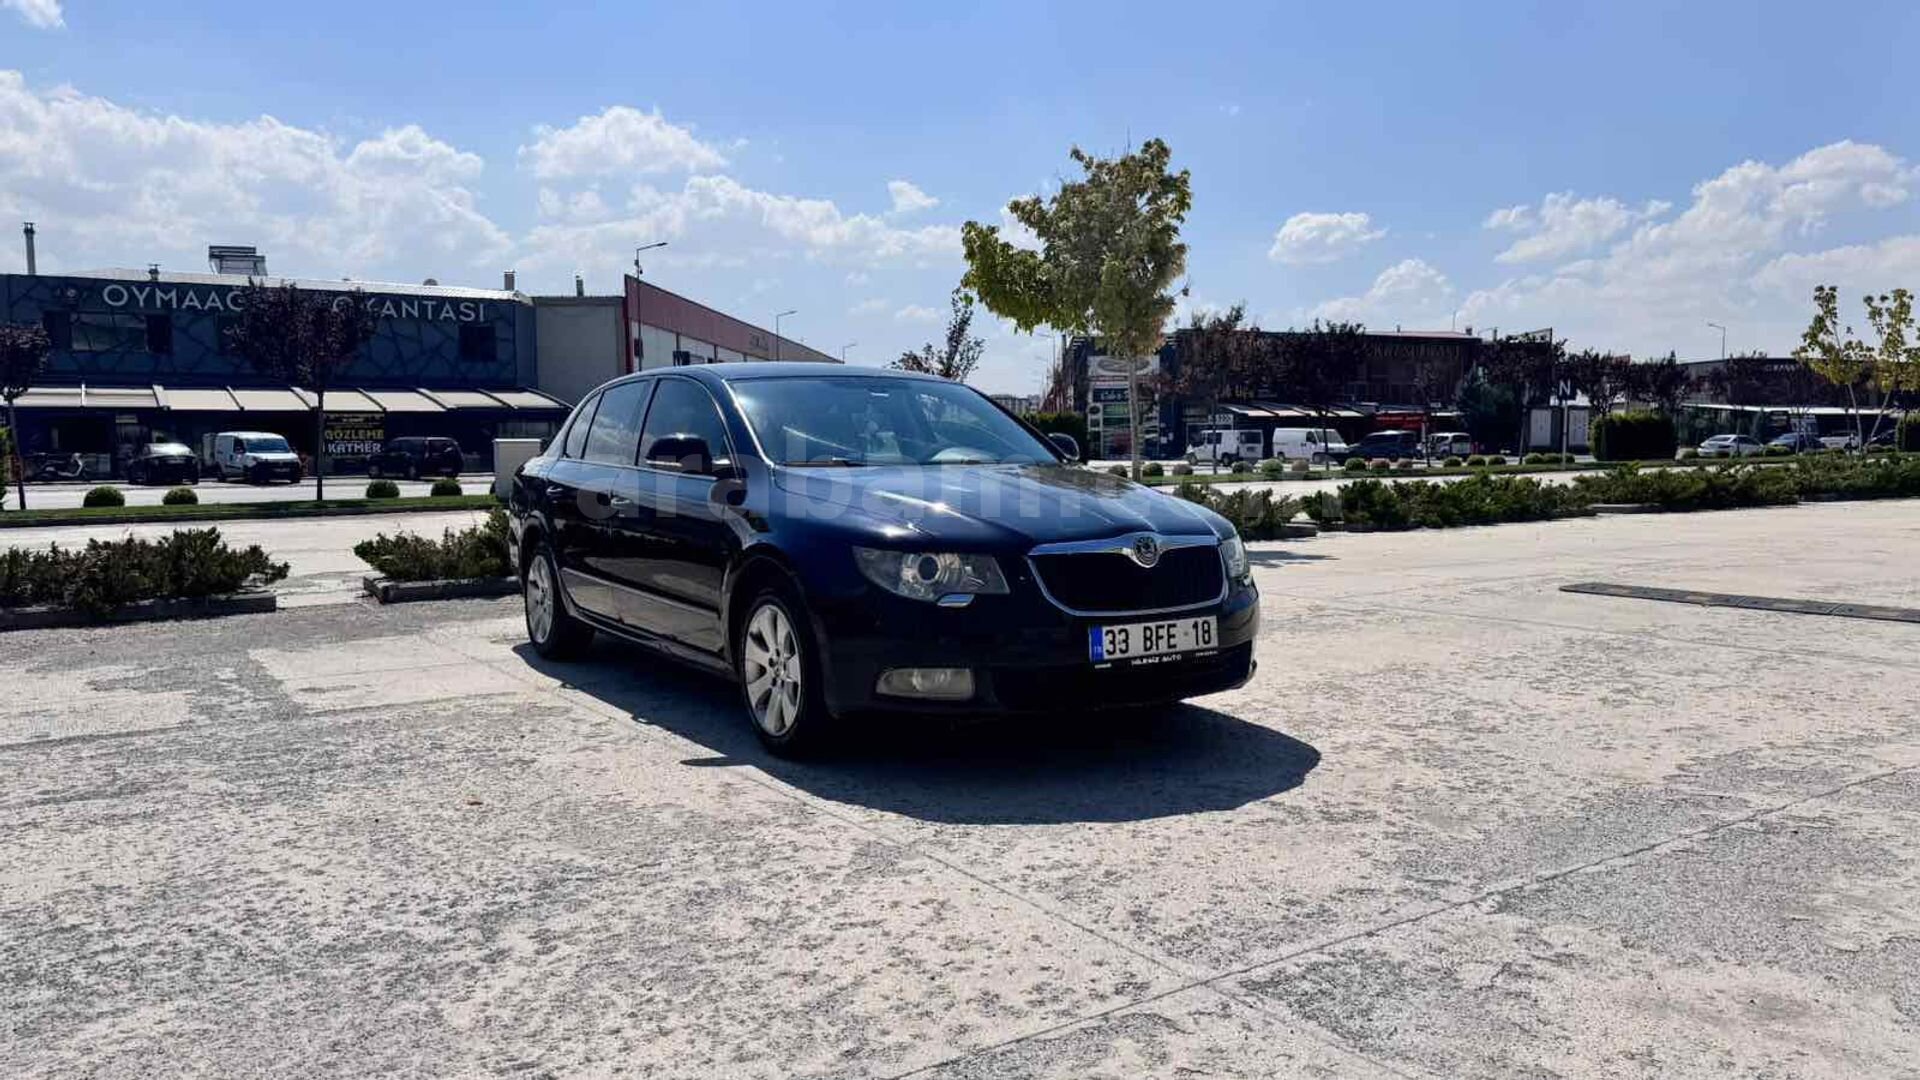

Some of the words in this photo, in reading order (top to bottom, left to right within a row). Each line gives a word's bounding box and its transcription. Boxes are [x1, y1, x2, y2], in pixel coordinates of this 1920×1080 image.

[103, 284, 250, 312] OYMAAĞ
[1559, 379, 1571, 396] N
[327, 442, 382, 453] KATMER
[1105, 628, 1129, 655] 33
[1143, 623, 1177, 652] BFE
[1192, 619, 1211, 646] 18
